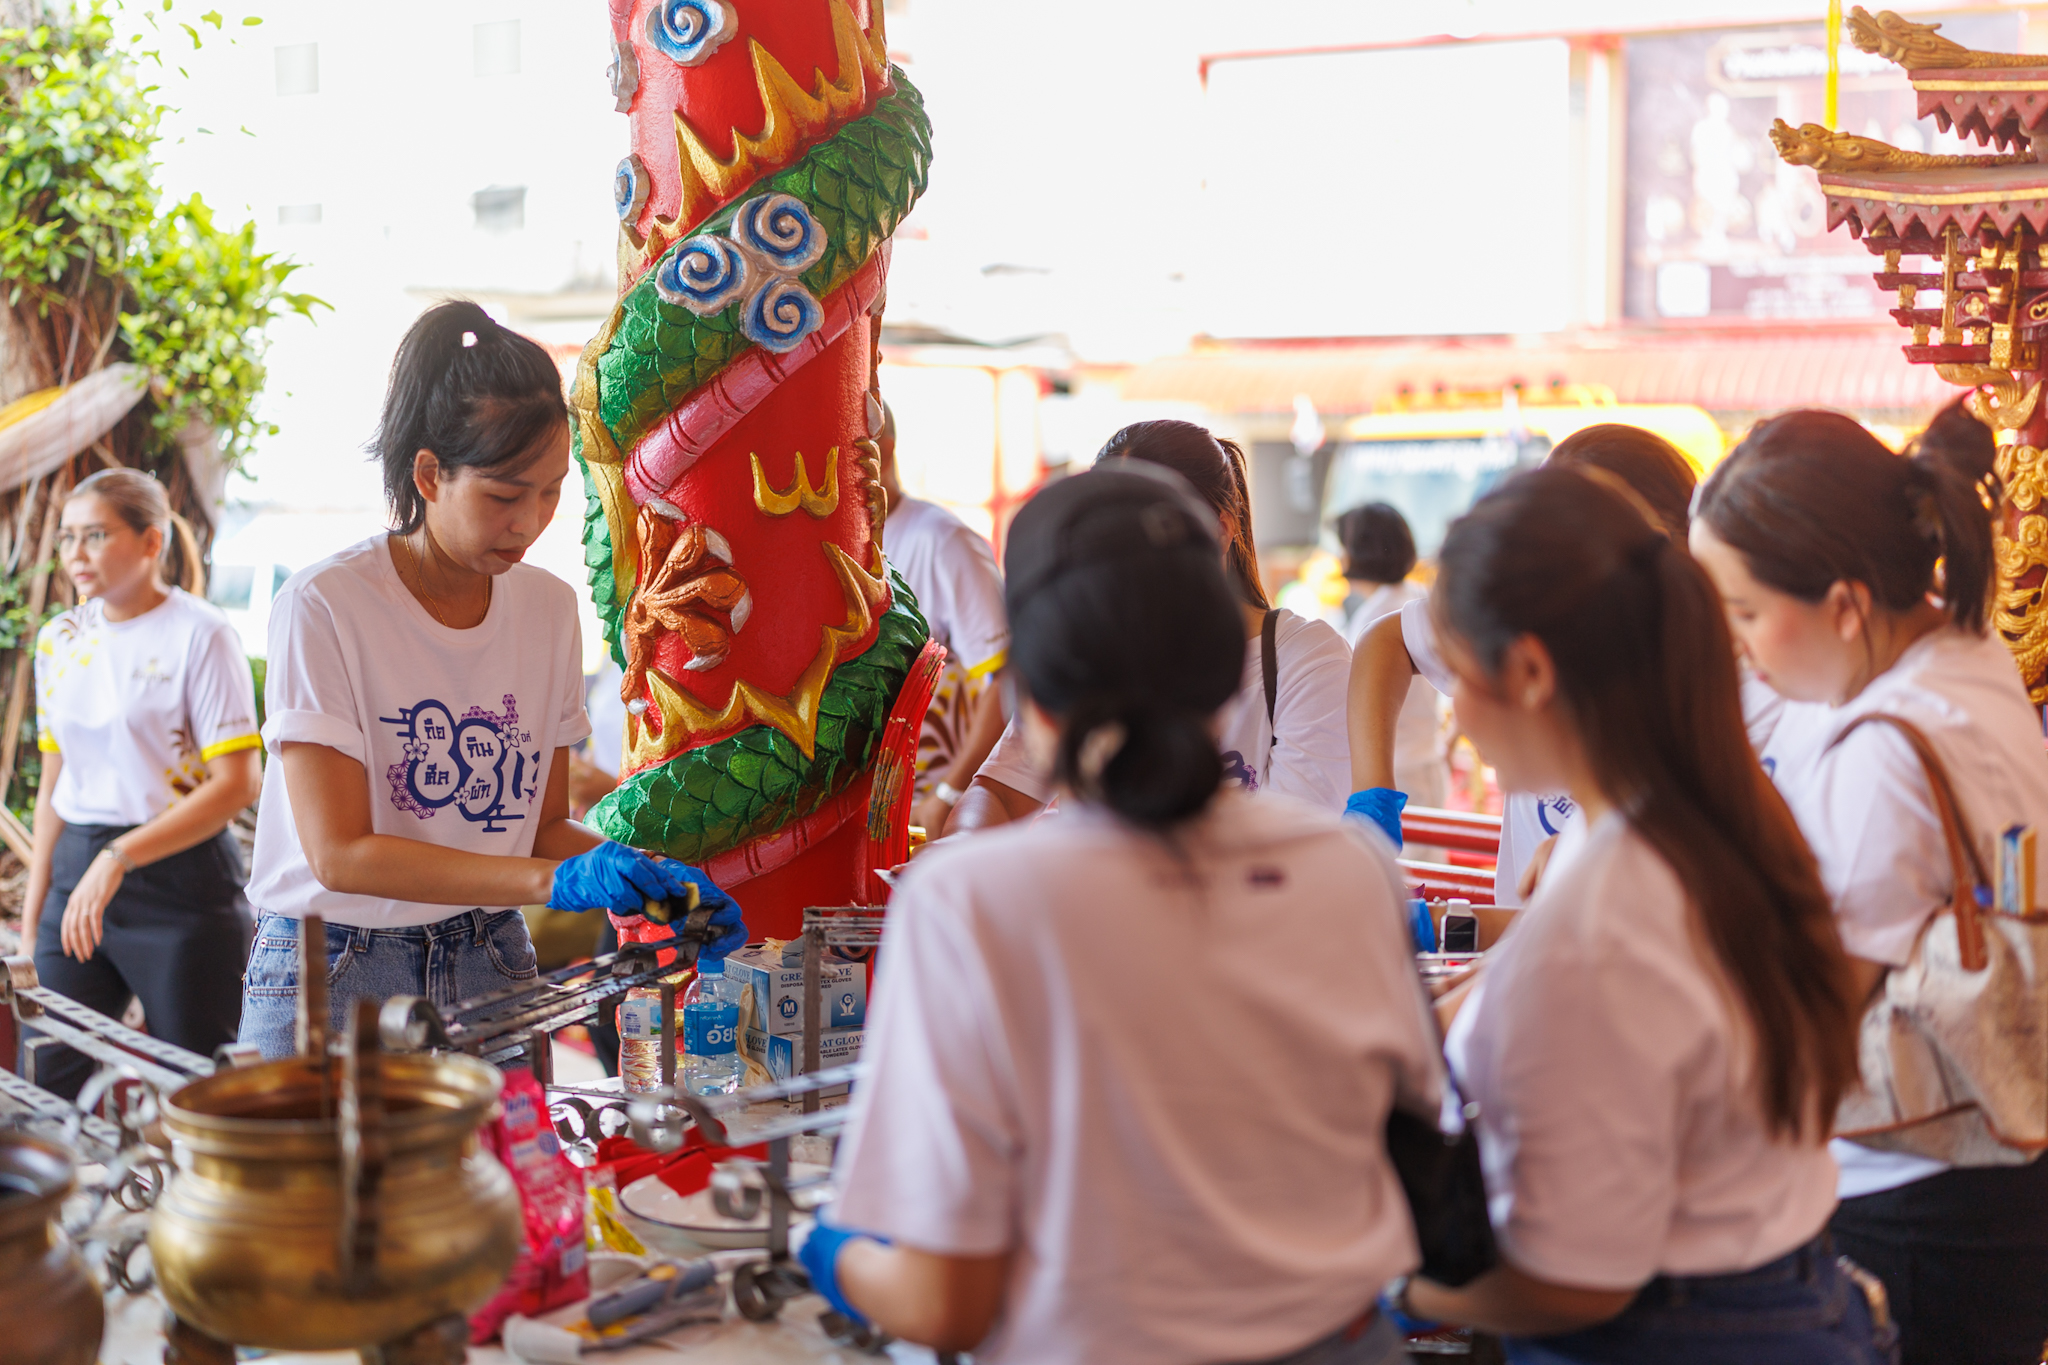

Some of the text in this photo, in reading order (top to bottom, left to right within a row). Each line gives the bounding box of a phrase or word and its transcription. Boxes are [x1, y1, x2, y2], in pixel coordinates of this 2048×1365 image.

[466, 736, 494, 758] กิน
[424, 762, 450, 786] ศีล
[470, 778, 492, 800] ผัก
[732, 966, 750, 980] GLOVE
[780, 972, 803, 982] GRE
[784, 1002, 794, 1013] M
[835, 1034, 867, 1046] GLOVE
